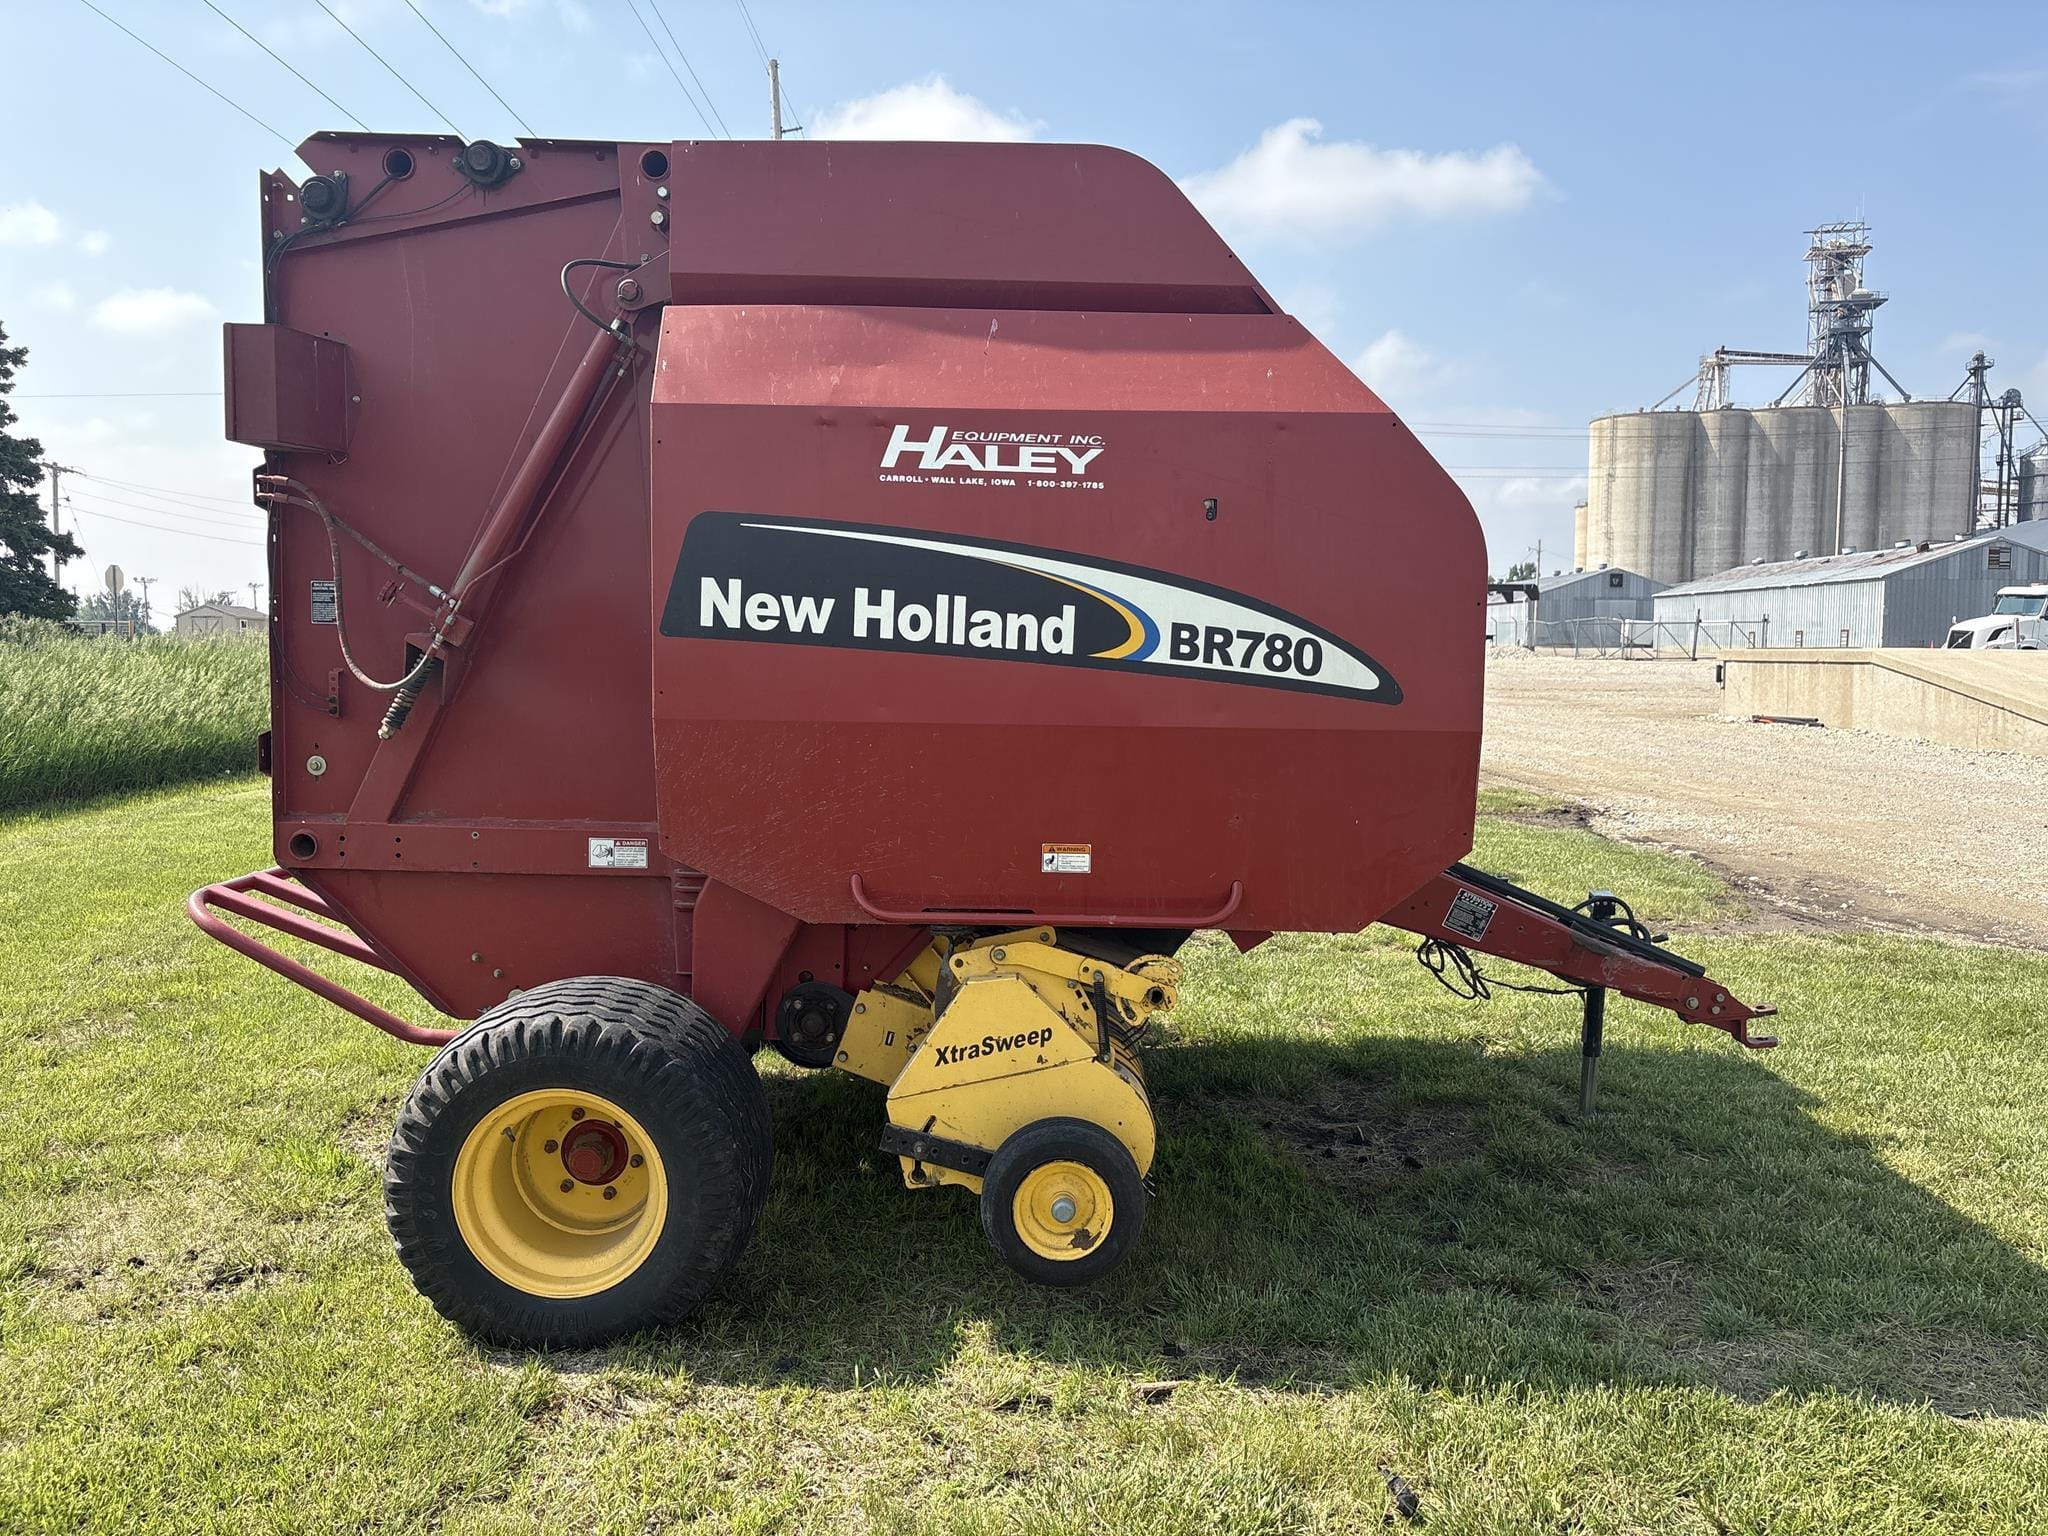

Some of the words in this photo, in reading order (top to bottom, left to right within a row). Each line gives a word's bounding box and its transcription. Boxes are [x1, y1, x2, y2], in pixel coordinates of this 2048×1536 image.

[880, 425, 1104, 475] HALEY
[952, 431, 1062, 443] EQUIPMENT
[1069, 435, 1106, 445] INC.
[879, 474, 923, 483] CARROLL
[931, 476, 956, 484] WALL
[959, 477, 988, 487] LAKE,
[991, 478, 1016, 486] IOWA
[1027, 480, 1105, 489] 1-800-397-1785
[700, 577, 836, 634] New
[853, 587, 1076, 655] Holland
[1169, 622, 1323, 676] BR780
[934, 1027, 1053, 1067] XtraSweep
